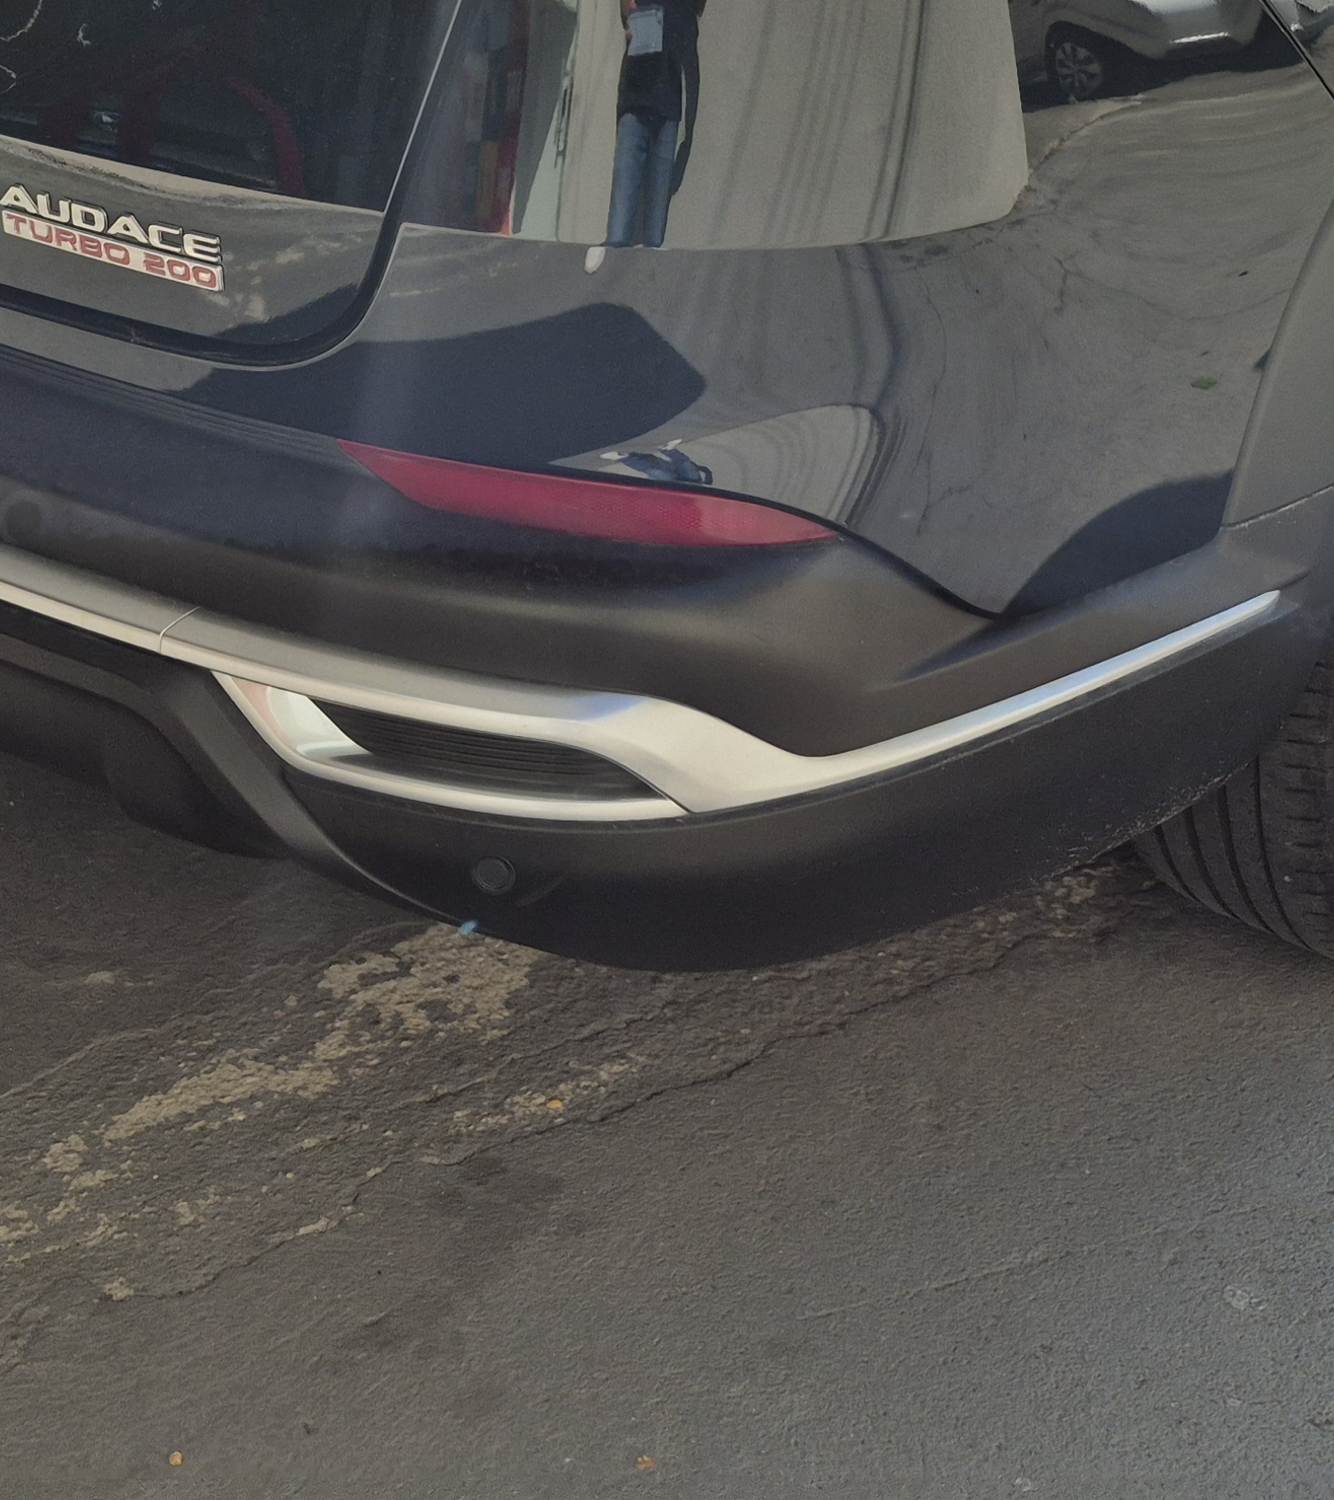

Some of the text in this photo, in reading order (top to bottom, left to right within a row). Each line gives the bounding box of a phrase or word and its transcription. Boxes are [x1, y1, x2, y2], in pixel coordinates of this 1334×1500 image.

[0, 182, 222, 263] AUDACE
[6, 213, 217, 289] TURBO 200
